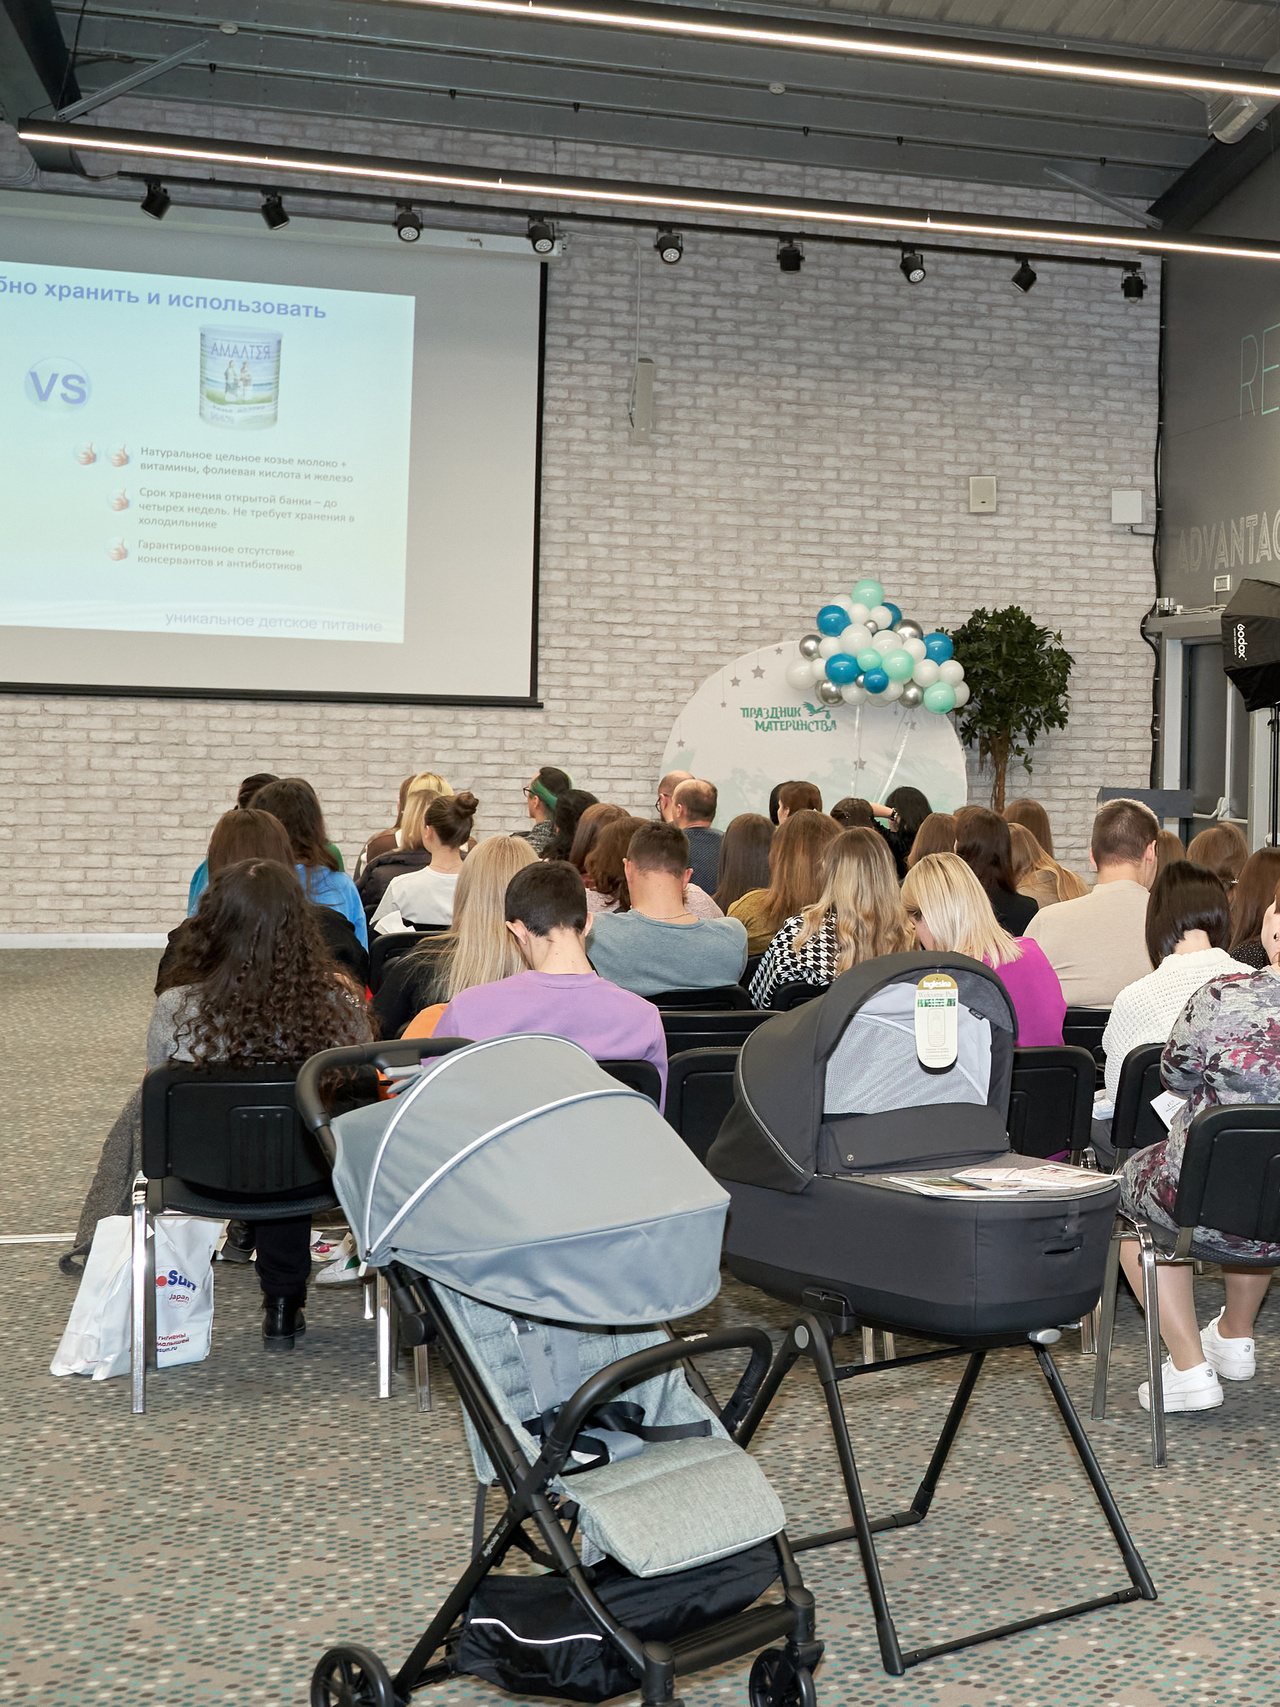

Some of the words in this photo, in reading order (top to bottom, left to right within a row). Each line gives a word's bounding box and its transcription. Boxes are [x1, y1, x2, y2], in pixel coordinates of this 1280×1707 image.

[44, 279, 140, 304] хранить
[147, 290, 161, 306] и
[168, 294, 327, 319] использовать
[29, 371, 88, 405] VS
[141, 446, 212, 461] Натуральное
[215, 452, 261, 464] цельное
[264, 455, 294, 466] козье
[297, 458, 338, 469] молоко
[140, 462, 200, 475] витамины,
[202, 464, 256, 478] фолиевая
[258, 469, 301, 480] кислота
[304, 472, 311, 480] и
[313, 473, 354, 483] железо
[139, 487, 166, 500] Срок
[169, 490, 222, 501] хранения
[224, 493, 276, 505] открытой
[279, 495, 312, 506] банки
[323, 499, 338, 510] до
[138, 502, 184, 515] четырех
[187, 505, 230, 517] недель.
[233, 507, 248, 516] Не
[250, 509, 292, 521] требует
[295, 512, 346, 523] хранения
[348, 515, 355, 523] в
[138, 516, 218, 529] холодильнике
[138, 539, 235, 554] Гарантированное
[237, 546, 295, 557] отсутствие
[137, 555, 214, 568] консервантов
[216, 559, 224, 567] и
[226, 558, 303, 571] антибиотиков
[164, 611, 255, 627] уникальное
[258, 616, 318, 630] детское
[321, 620, 383, 633] питание
[1237, 623, 1248, 659] Godox
[740, 706, 802, 720] ПРАЗДНИК
[754, 719, 837, 732] МАТЕРИНСТВА
[167, 1269, 197, 1291] Sun
[169, 1293, 190, 1302] Japan
